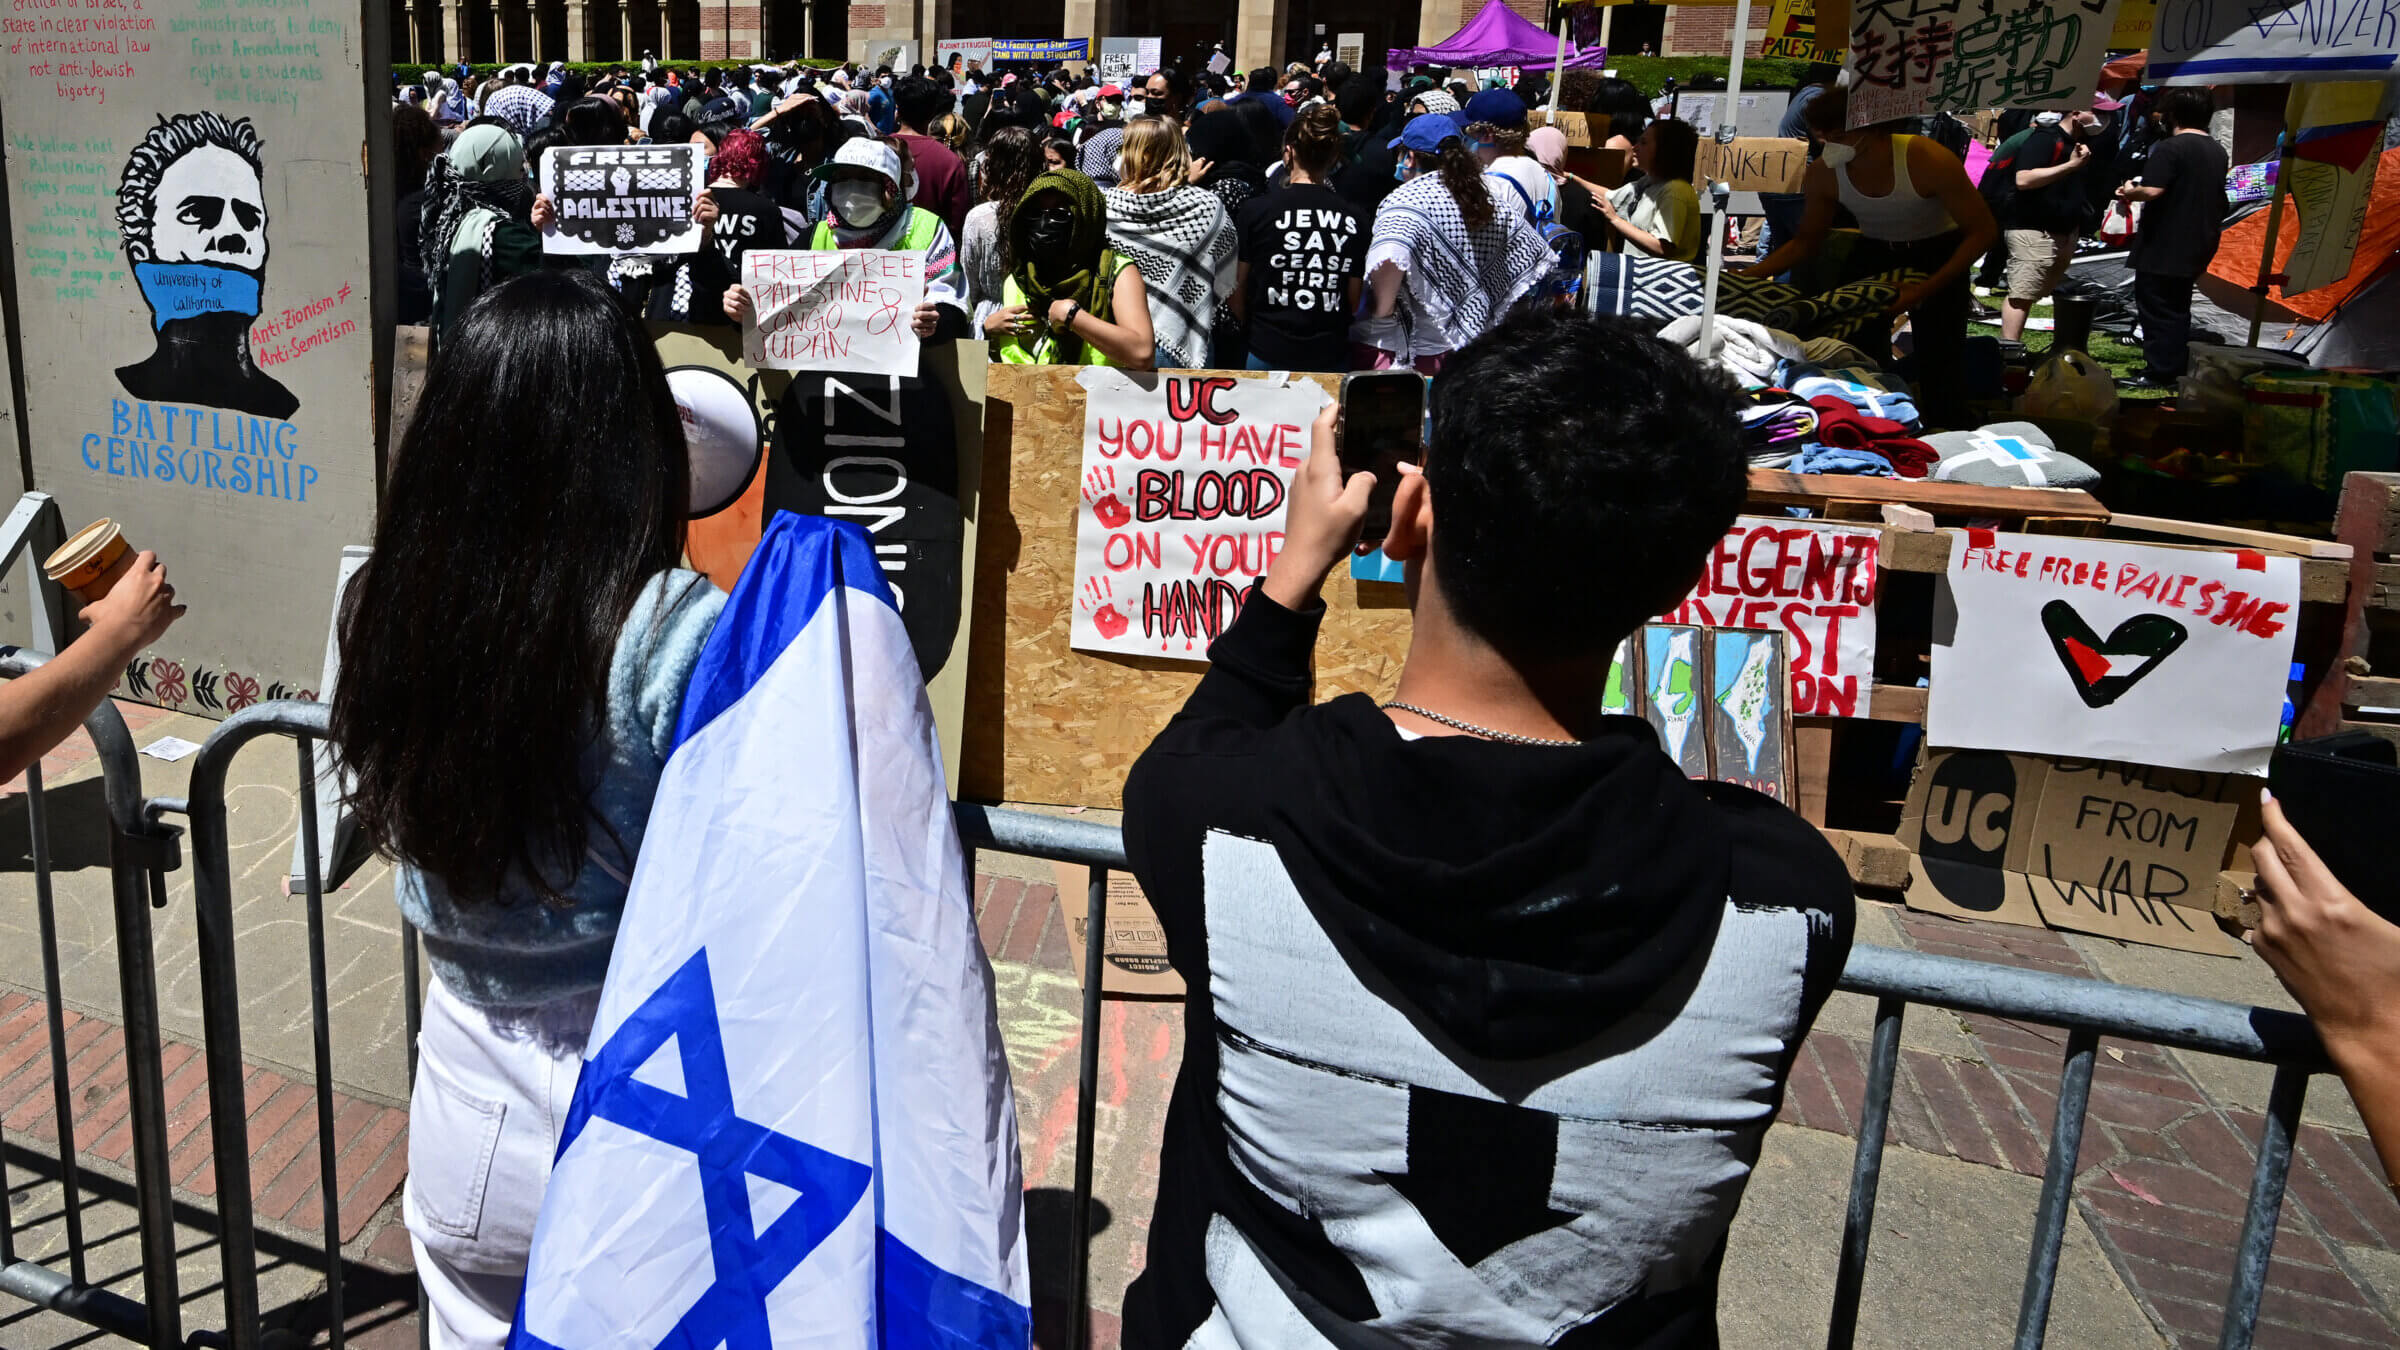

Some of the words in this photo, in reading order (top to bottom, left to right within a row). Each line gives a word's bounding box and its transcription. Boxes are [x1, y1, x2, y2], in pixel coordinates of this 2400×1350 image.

[40, 16, 52, 33] in
[56, 17, 88, 33] clear
[94, 14, 156, 32] violation
[308, 15, 341, 40] deny
[12, 38, 22, 55] of
[28, 36, 119, 55] international
[127, 36, 151, 54] law
[232, 37, 320, 57] Amendment
[993, 51, 1010, 59] TAND
[1012, 51, 1029, 59] WITH
[1031, 51, 1045, 59] OUR
[1046, 50, 1081, 59] STUDENTS
[1009, 42, 1034, 50] Faculty
[1761, 37, 1843, 64] PALESTINE
[30, 60, 54, 78] not
[59, 60, 136, 78] anti-Jewish
[190, 63, 232, 86] rights
[57, 82, 105, 104] bigotry
[570, 150, 672, 166] FREE
[563, 197, 687, 222] PALESTINE
[1275, 209, 1358, 234] JEWS
[714, 214, 758, 236] WS
[1283, 231, 1348, 252] SAY
[750, 254, 831, 280] FREE
[840, 252, 914, 278] FREE
[1270, 254, 1352, 272] CEASE
[153, 270, 207, 294] University
[211, 273, 224, 289] of
[1282, 271, 1340, 289] FIRE
[173, 297, 225, 312] California
[752, 280, 877, 309] PALESTINE
[1268, 287, 1341, 312] NOW
[252, 296, 335, 346] Anti-Zionism
[758, 303, 844, 334] CONGO
[260, 318, 357, 369] Anti-Semitism
[1167, 377, 1240, 425] UC
[112, 398, 298, 460] BATTLING
[1099, 417, 1182, 461] YOU
[1200, 424, 1302, 468] HAVE
[82, 433, 319, 502] CENSORSHIP
[1136, 468, 1286, 522] BLOOD
[1104, 531, 1161, 572] ON
[1696, 525, 1879, 606] EGENTS
[1961, 547, 2033, 579] FREE
[2039, 555, 2108, 592] FREE
[1142, 577, 1254, 640] HAND
[1925, 784, 2012, 852] UC
[2075, 795, 2199, 852] FROM
[2044, 843, 2195, 932] WAR
[1804, 907, 1833, 940] TM
